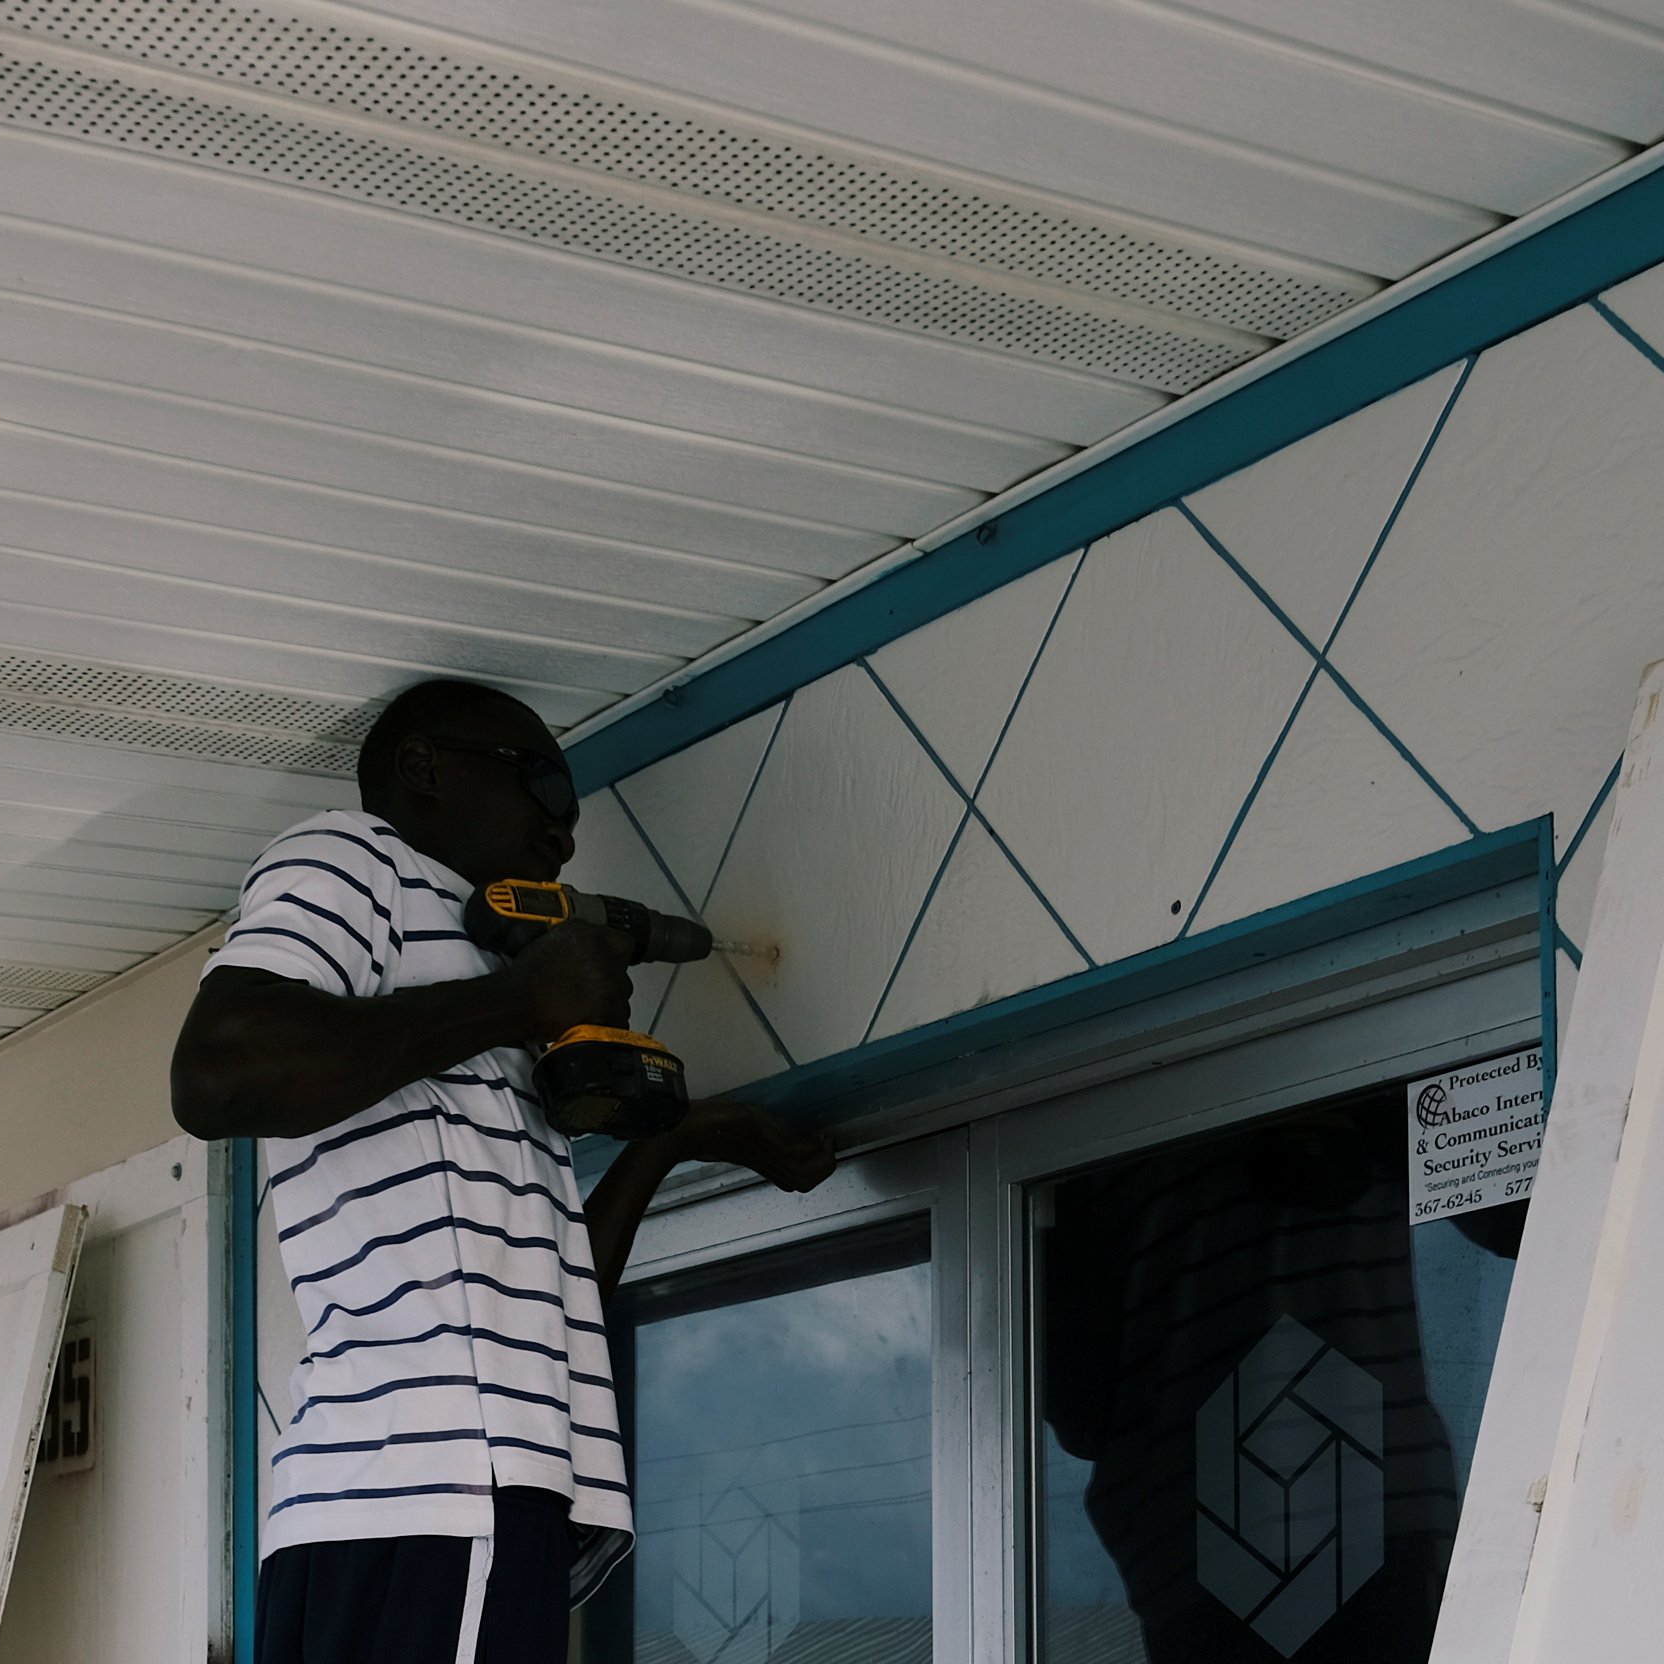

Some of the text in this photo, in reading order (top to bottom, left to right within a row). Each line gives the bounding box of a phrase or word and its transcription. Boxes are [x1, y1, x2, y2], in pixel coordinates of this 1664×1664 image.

[1449, 1057, 1520, 1090] Protected
[1439, 1105, 1490, 1126] Abaco
[1416, 1138, 1429, 1155] &
[1424, 1149, 1491, 1176] Security
[1461, 1174, 1476, 1185] and
[1477, 1162, 1521, 1181] Connecting
[1414, 1188, 1483, 1217] 367-6245
